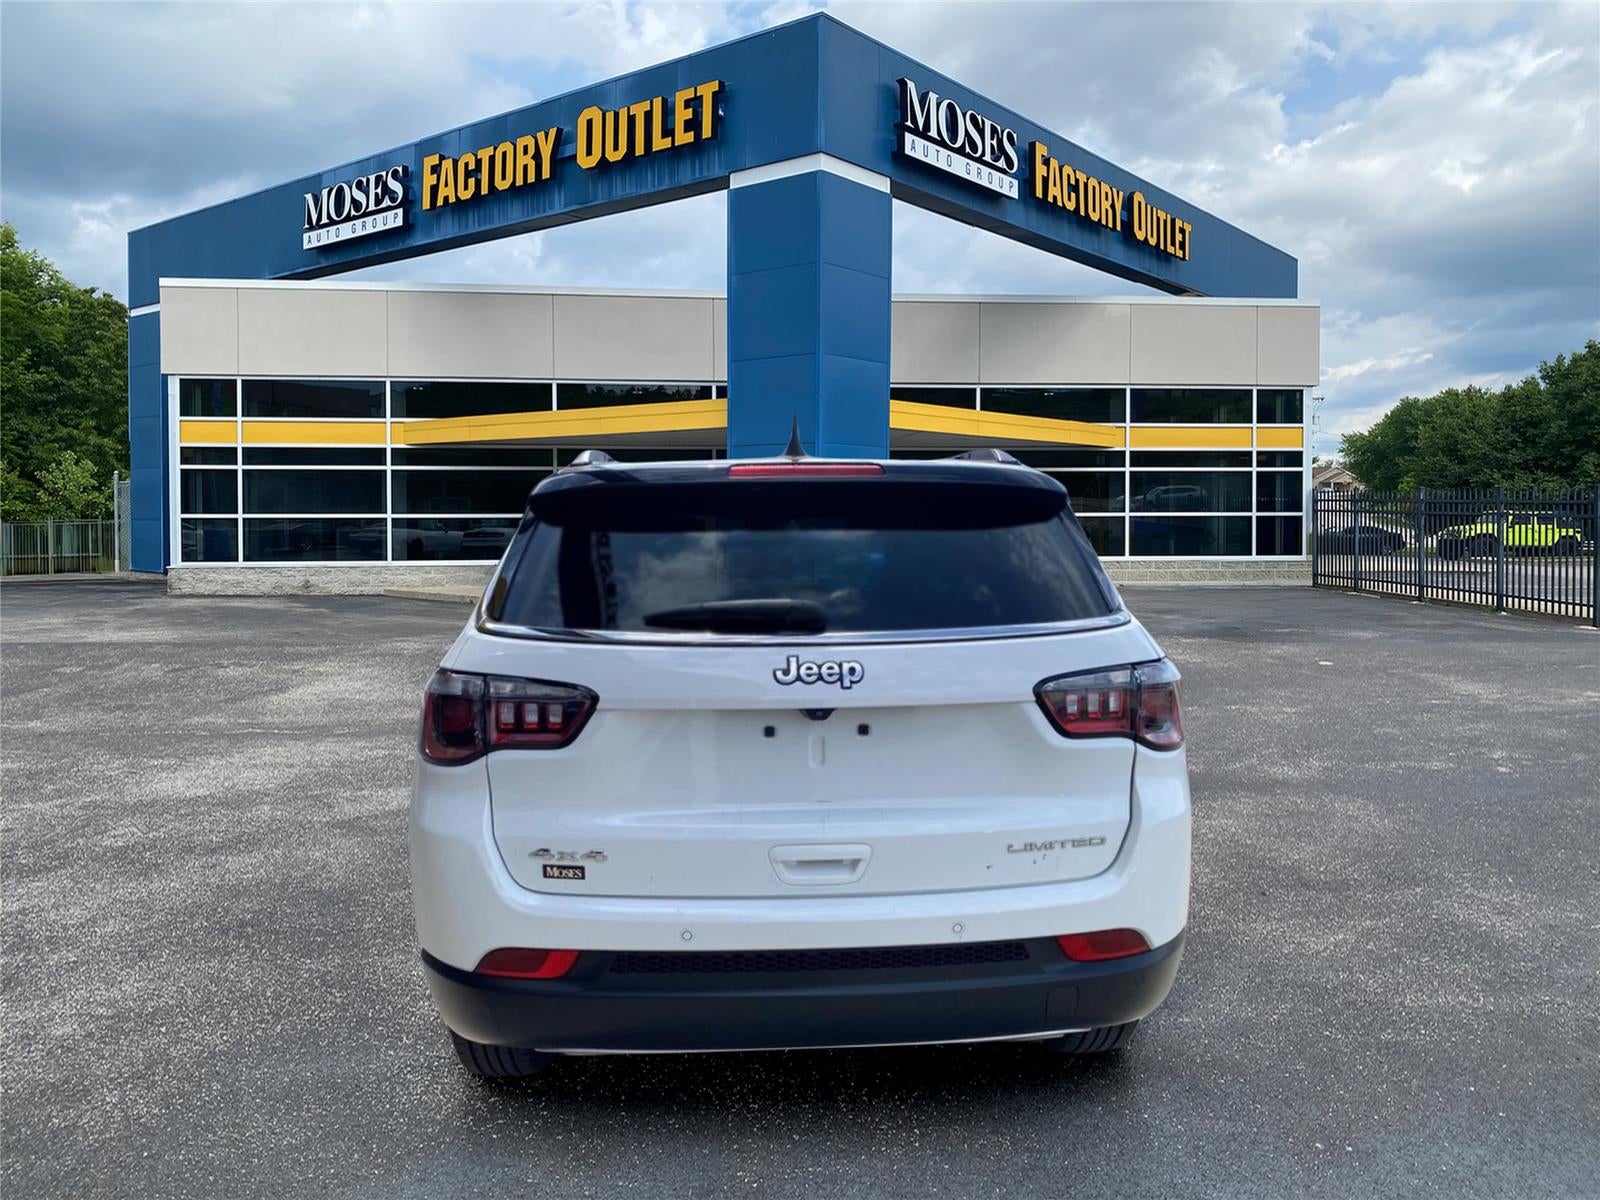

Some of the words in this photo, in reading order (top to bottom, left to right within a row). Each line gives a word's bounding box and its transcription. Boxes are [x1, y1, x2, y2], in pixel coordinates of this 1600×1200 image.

[422, 127, 560, 211] FACTORY
[575, 79, 721, 170] OUTLET
[903, 77, 1018, 174] MOSES
[910, 138, 953, 169] AUTO
[965, 161, 1015, 193] GROUP
[303, 165, 405, 229] MOSES
[1034, 140, 1124, 232] FACTORY
[1131, 191, 1192, 261] OUTLET
[306, 226, 341, 246] AUTO
[350, 212, 399, 234] GROUP
[773, 655, 865, 690] Jeep
[1007, 836, 1107, 854] LIMITED
